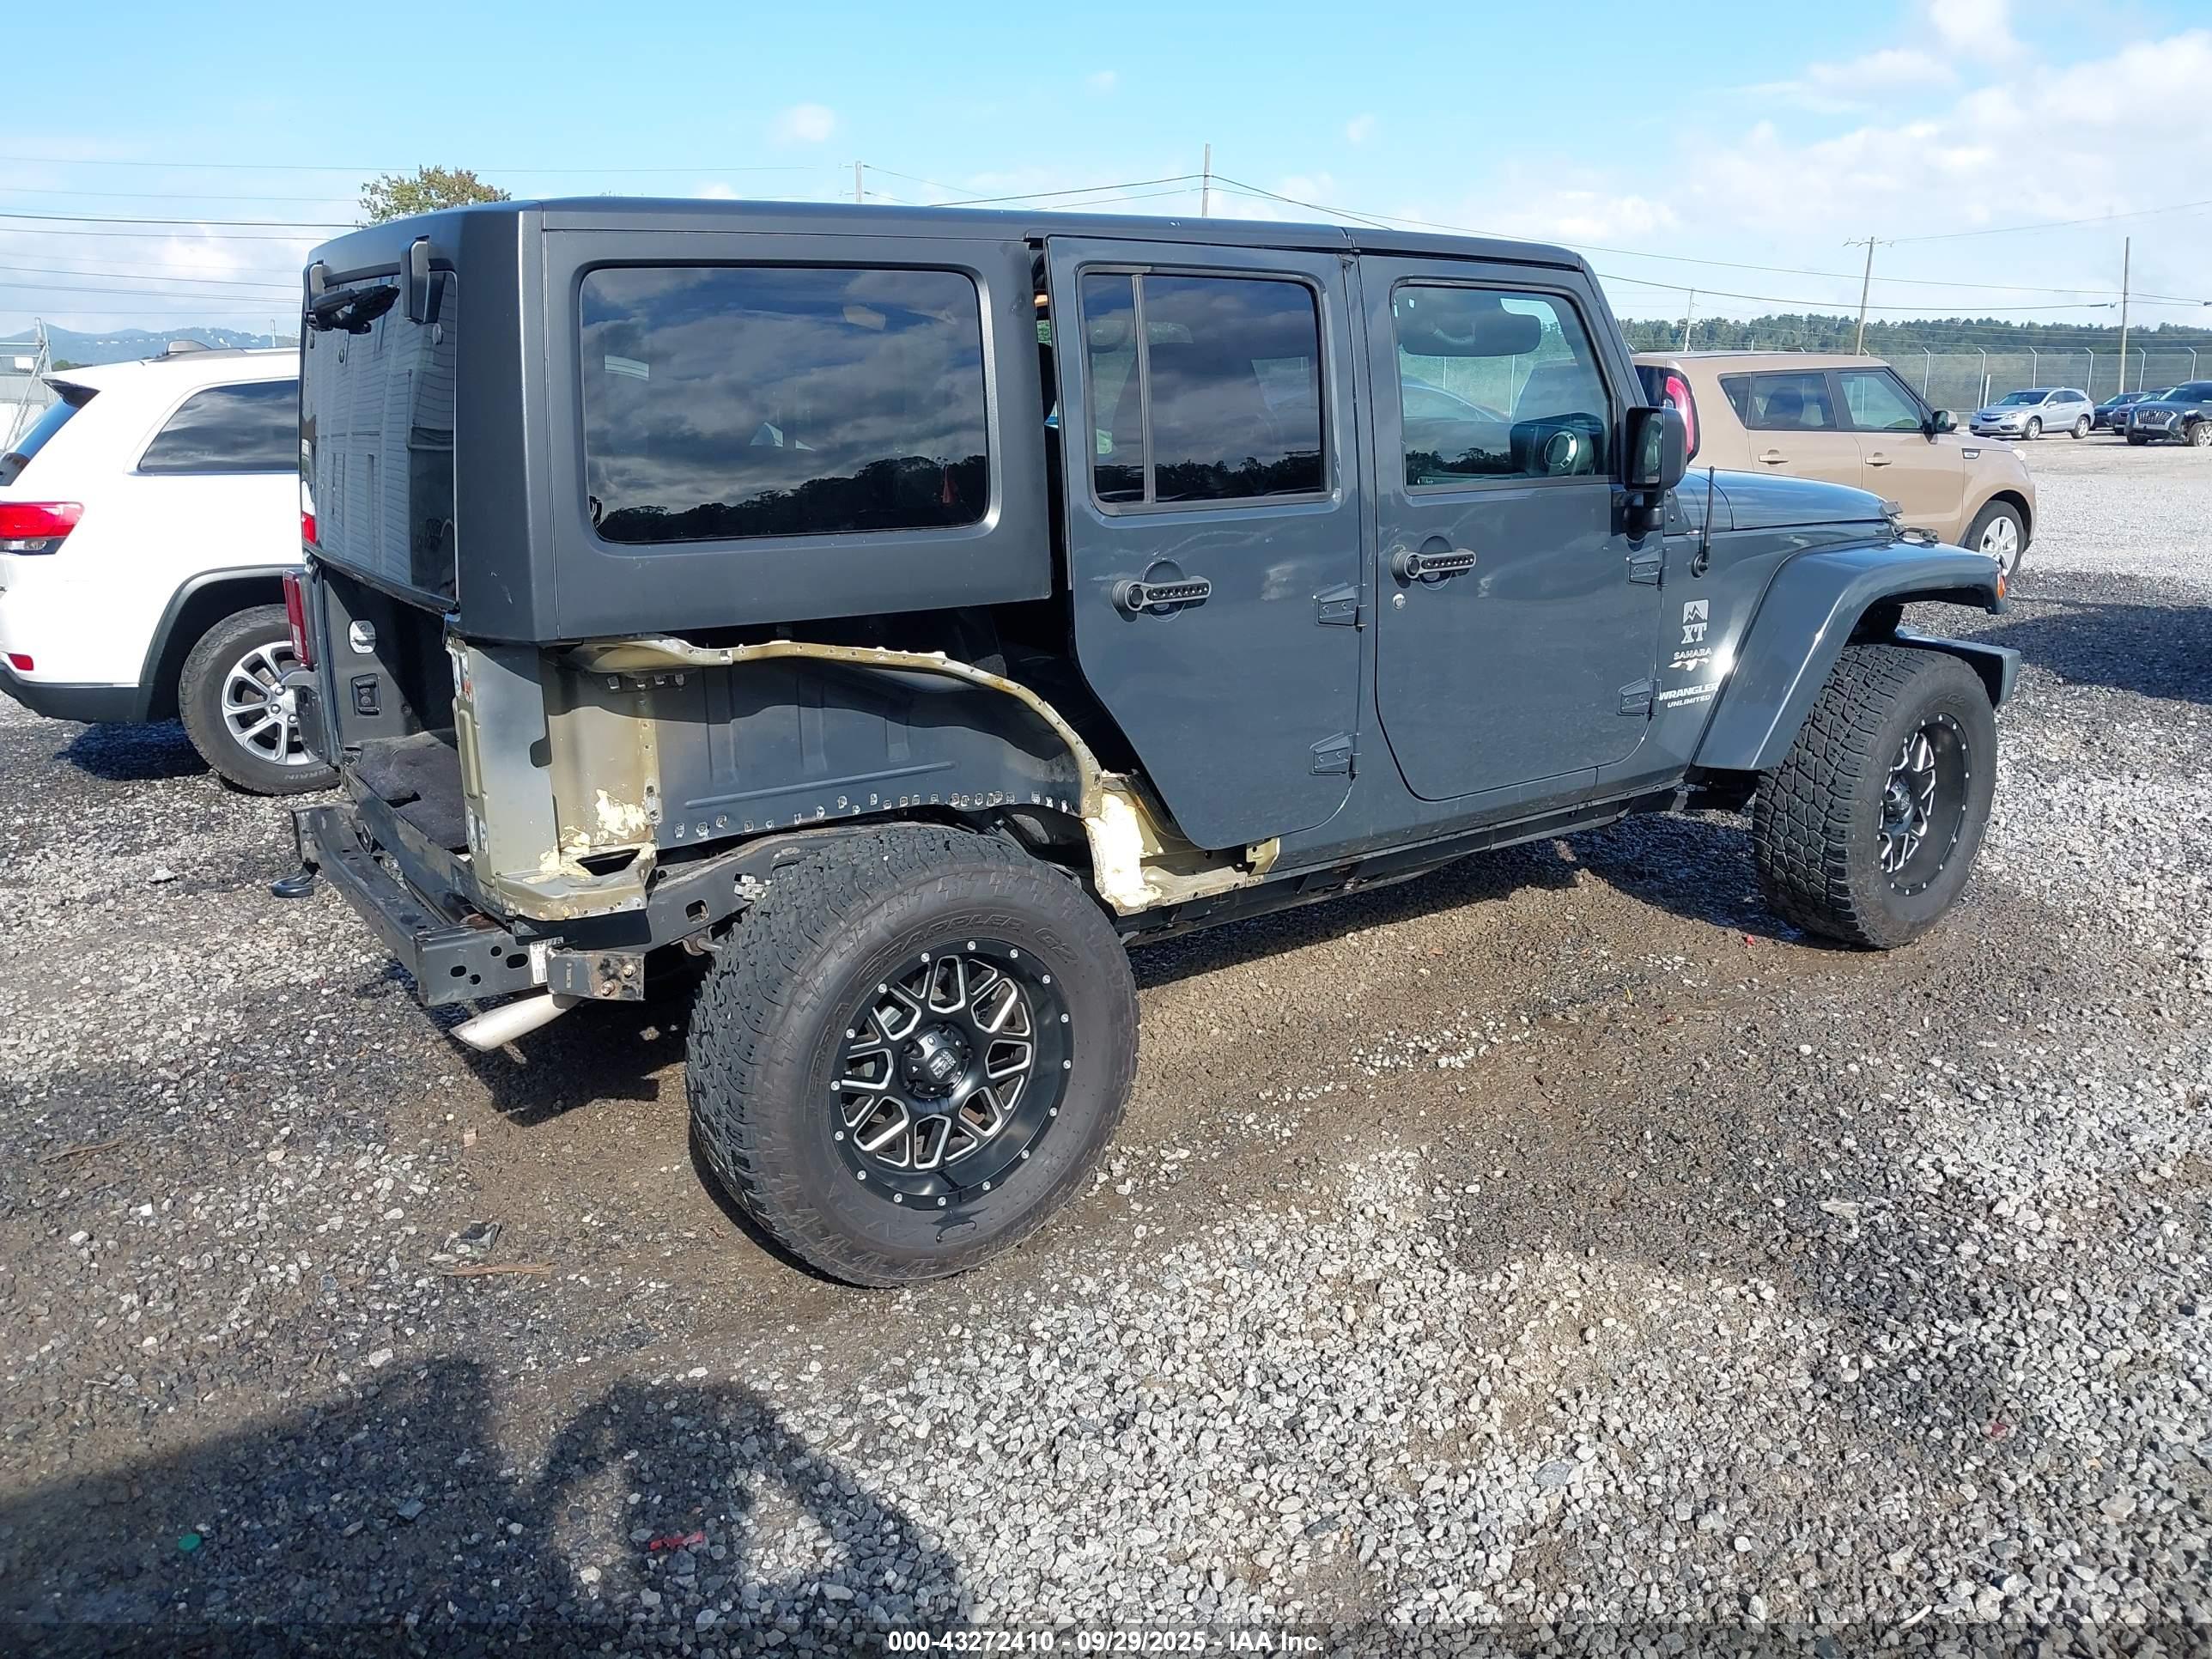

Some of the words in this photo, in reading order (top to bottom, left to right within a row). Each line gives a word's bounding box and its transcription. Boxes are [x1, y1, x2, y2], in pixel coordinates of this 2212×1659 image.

[1680, 622, 1708, 645] XT
[1673, 647, 1713, 660] SAHARA
[1658, 682, 1720, 701] WRANGLER
[1667, 694, 1711, 708] UNLIMITED
